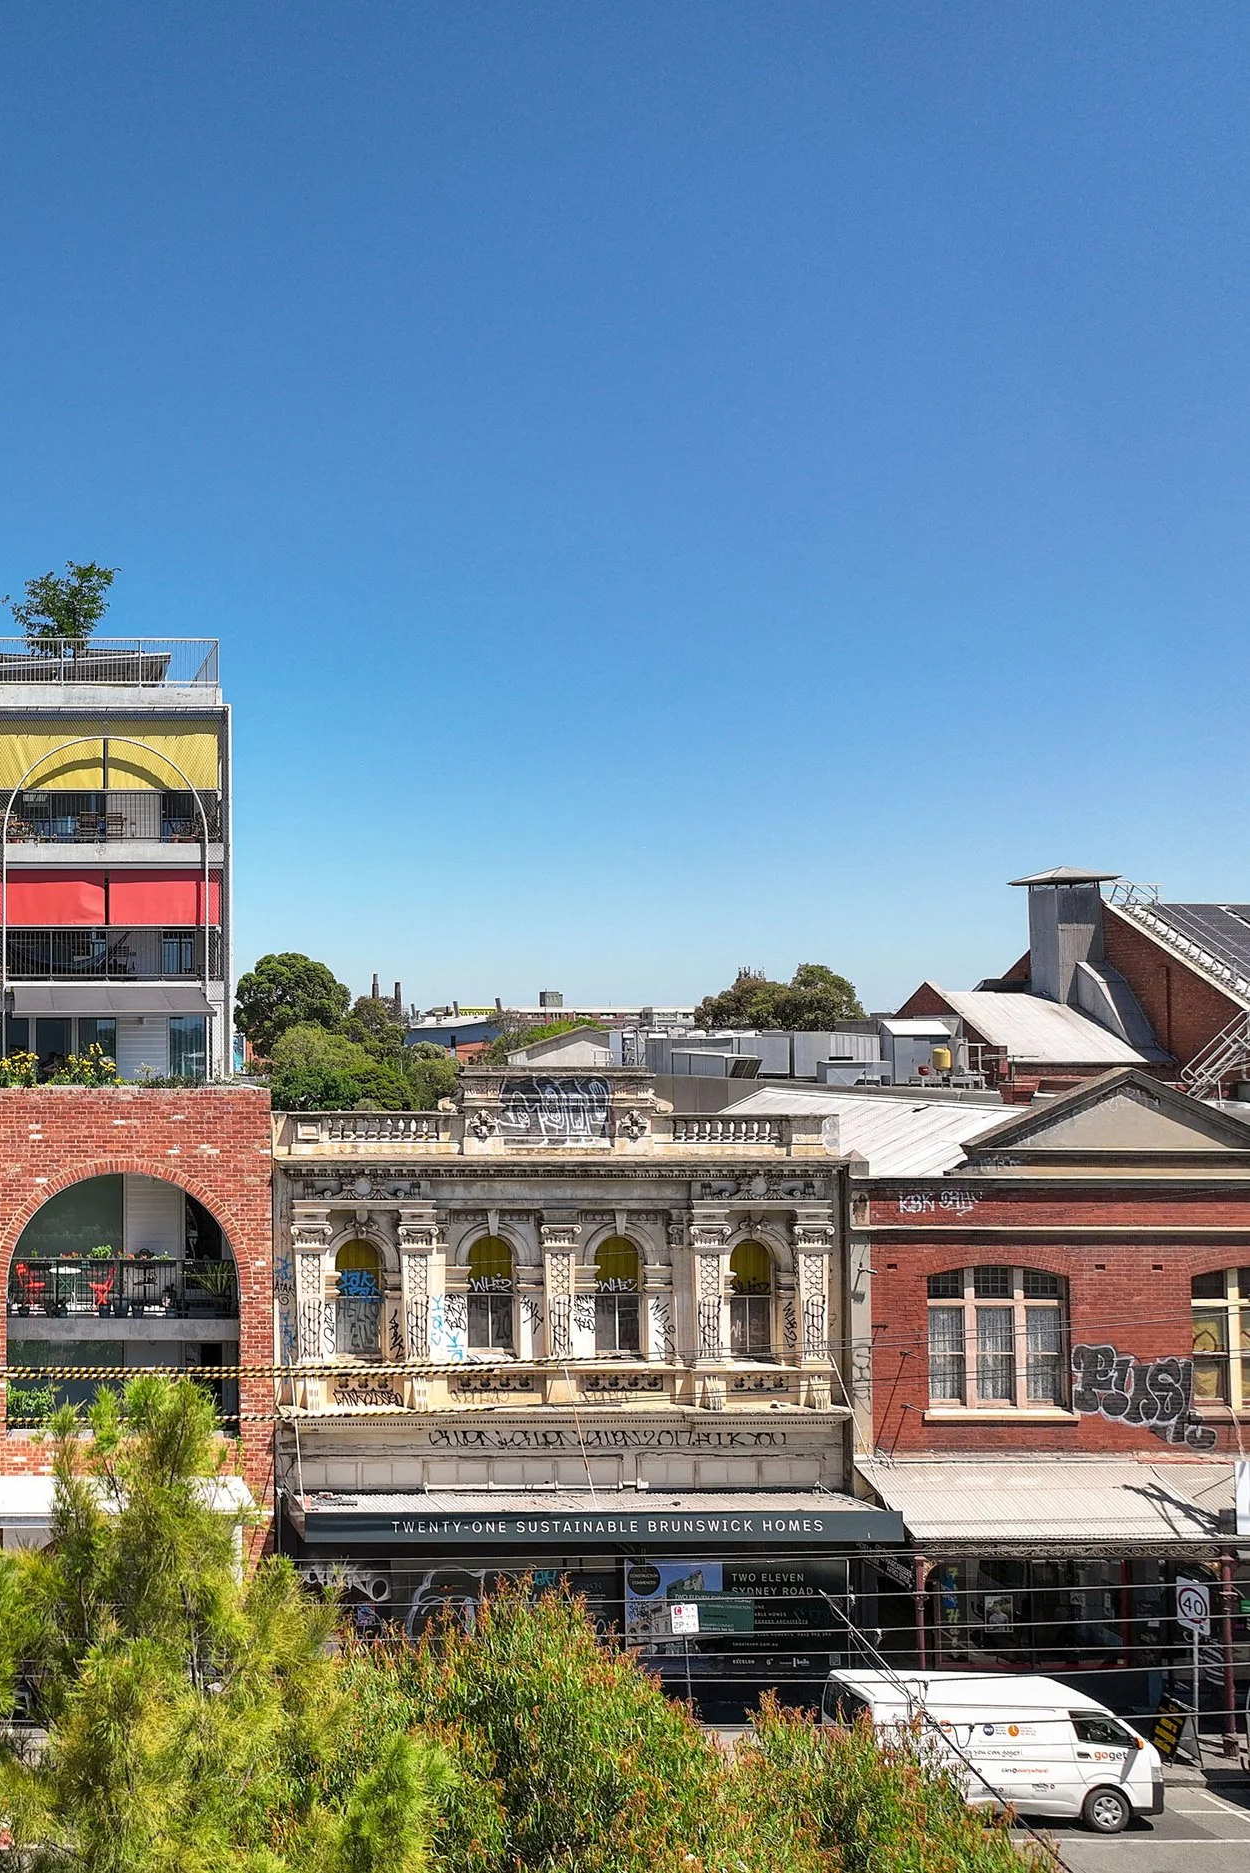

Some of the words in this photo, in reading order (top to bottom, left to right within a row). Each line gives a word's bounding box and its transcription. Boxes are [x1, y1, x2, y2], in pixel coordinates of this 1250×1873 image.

[392, 1521, 507, 1533] TWENTY-ONE
[516, 1520, 638, 1533] SUSTAINABLE
[648, 1520, 754, 1532] BRUNSWICK
[763, 1520, 824, 1532] HOMES
[732, 1573, 756, 1582] TWO
[761, 1573, 804, 1582] ELEVEN
[732, 1587, 777, 1596] SYDNEY
[782, 1587, 814, 1596] ROAD
[1183, 1597, 1203, 1612] 40
[1094, 1751, 1128, 1761] goget
